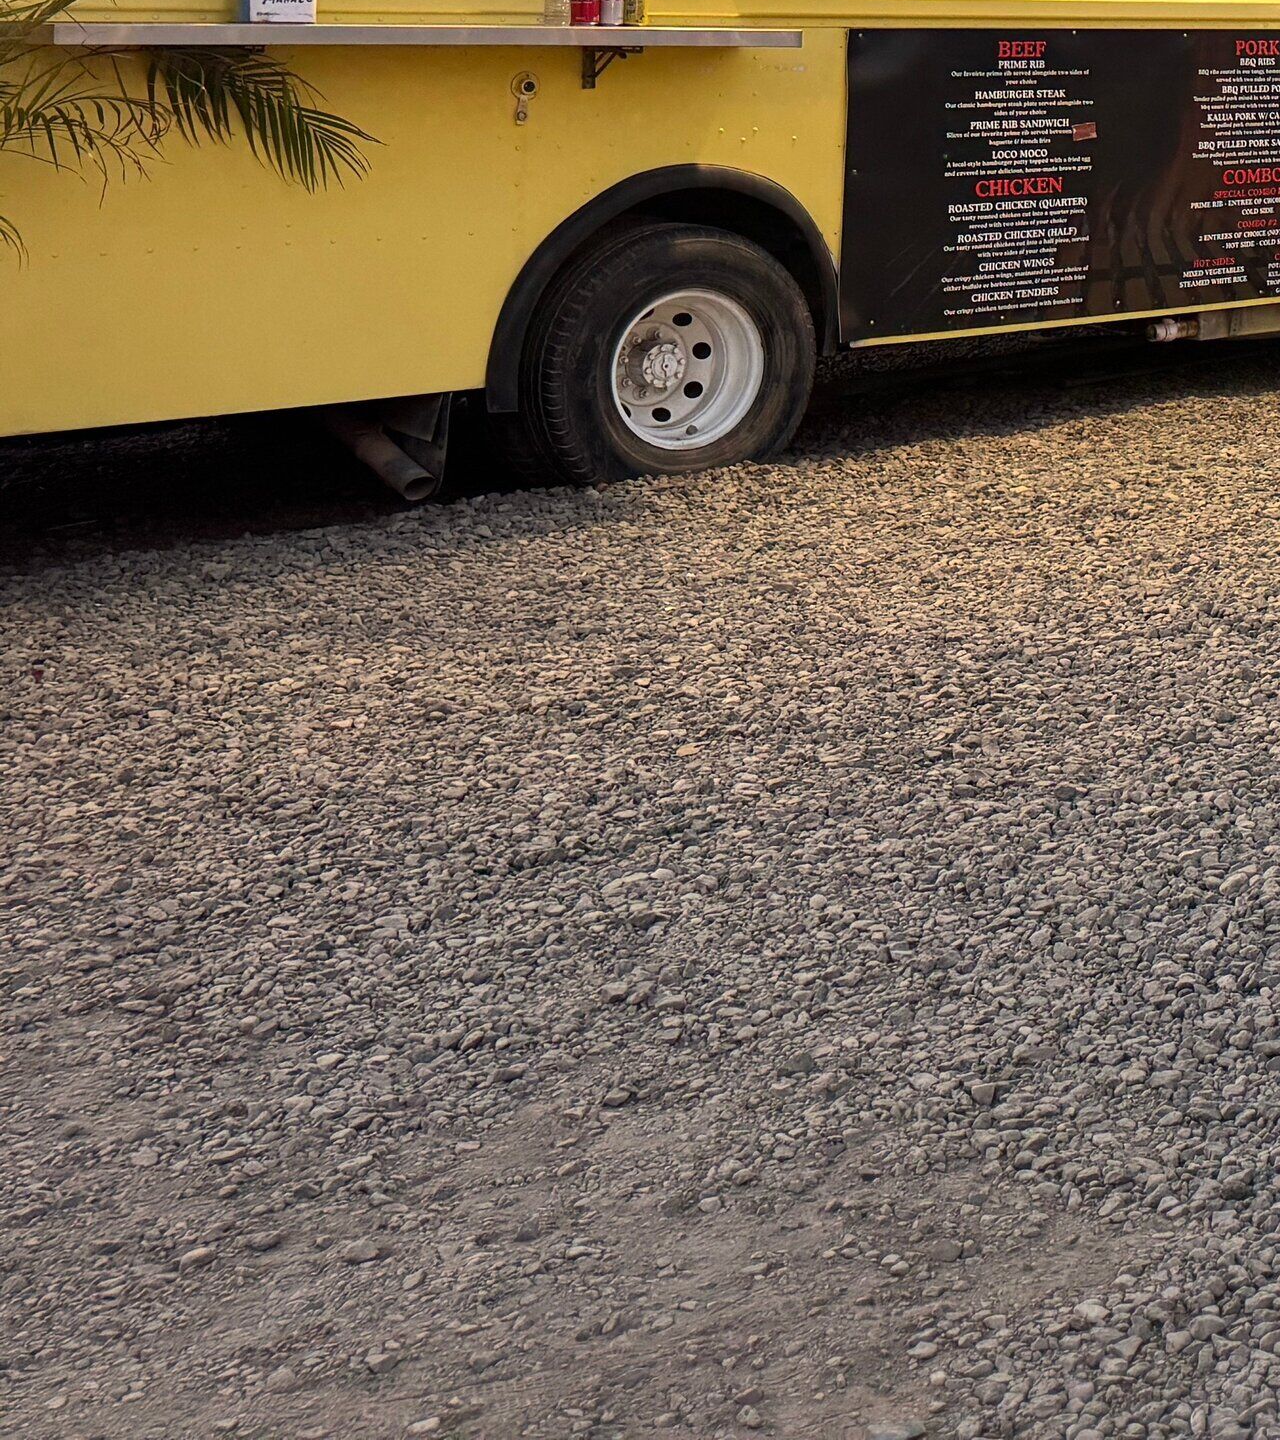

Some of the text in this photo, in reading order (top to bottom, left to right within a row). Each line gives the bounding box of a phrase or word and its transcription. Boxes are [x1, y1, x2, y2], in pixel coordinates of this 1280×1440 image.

[998, 41, 1047, 57] BEEF
[1235, 40, 1280, 56] PORK
[998, 60, 1045, 69] PRIME RIB
[1240, 58, 1256, 66] BBQ
[975, 89, 1066, 99] HAMBURGER STEAK
[1222, 86, 1238, 94] BBQ
[1240, 85, 1269, 93] PULLED
[971, 119, 1070, 130] PRIME RIB SANDWICH
[1199, 141, 1215, 150] BBQ
[1217, 140, 1247, 149] PULLED
[1248, 139, 1270, 147] PORK
[992, 149, 1048, 159] LOCO MOCO
[975, 177, 1063, 197] CHICKEN
[949, 197, 1087, 214] ROASTED CHICKEN (QUARTER)
[958, 227, 1077, 243] ROASTED CHICKEN (HALF)
[979, 258, 1055, 272] CHICKEN WINGS
[972, 287, 1059, 302] CHICKEN TENDERS
